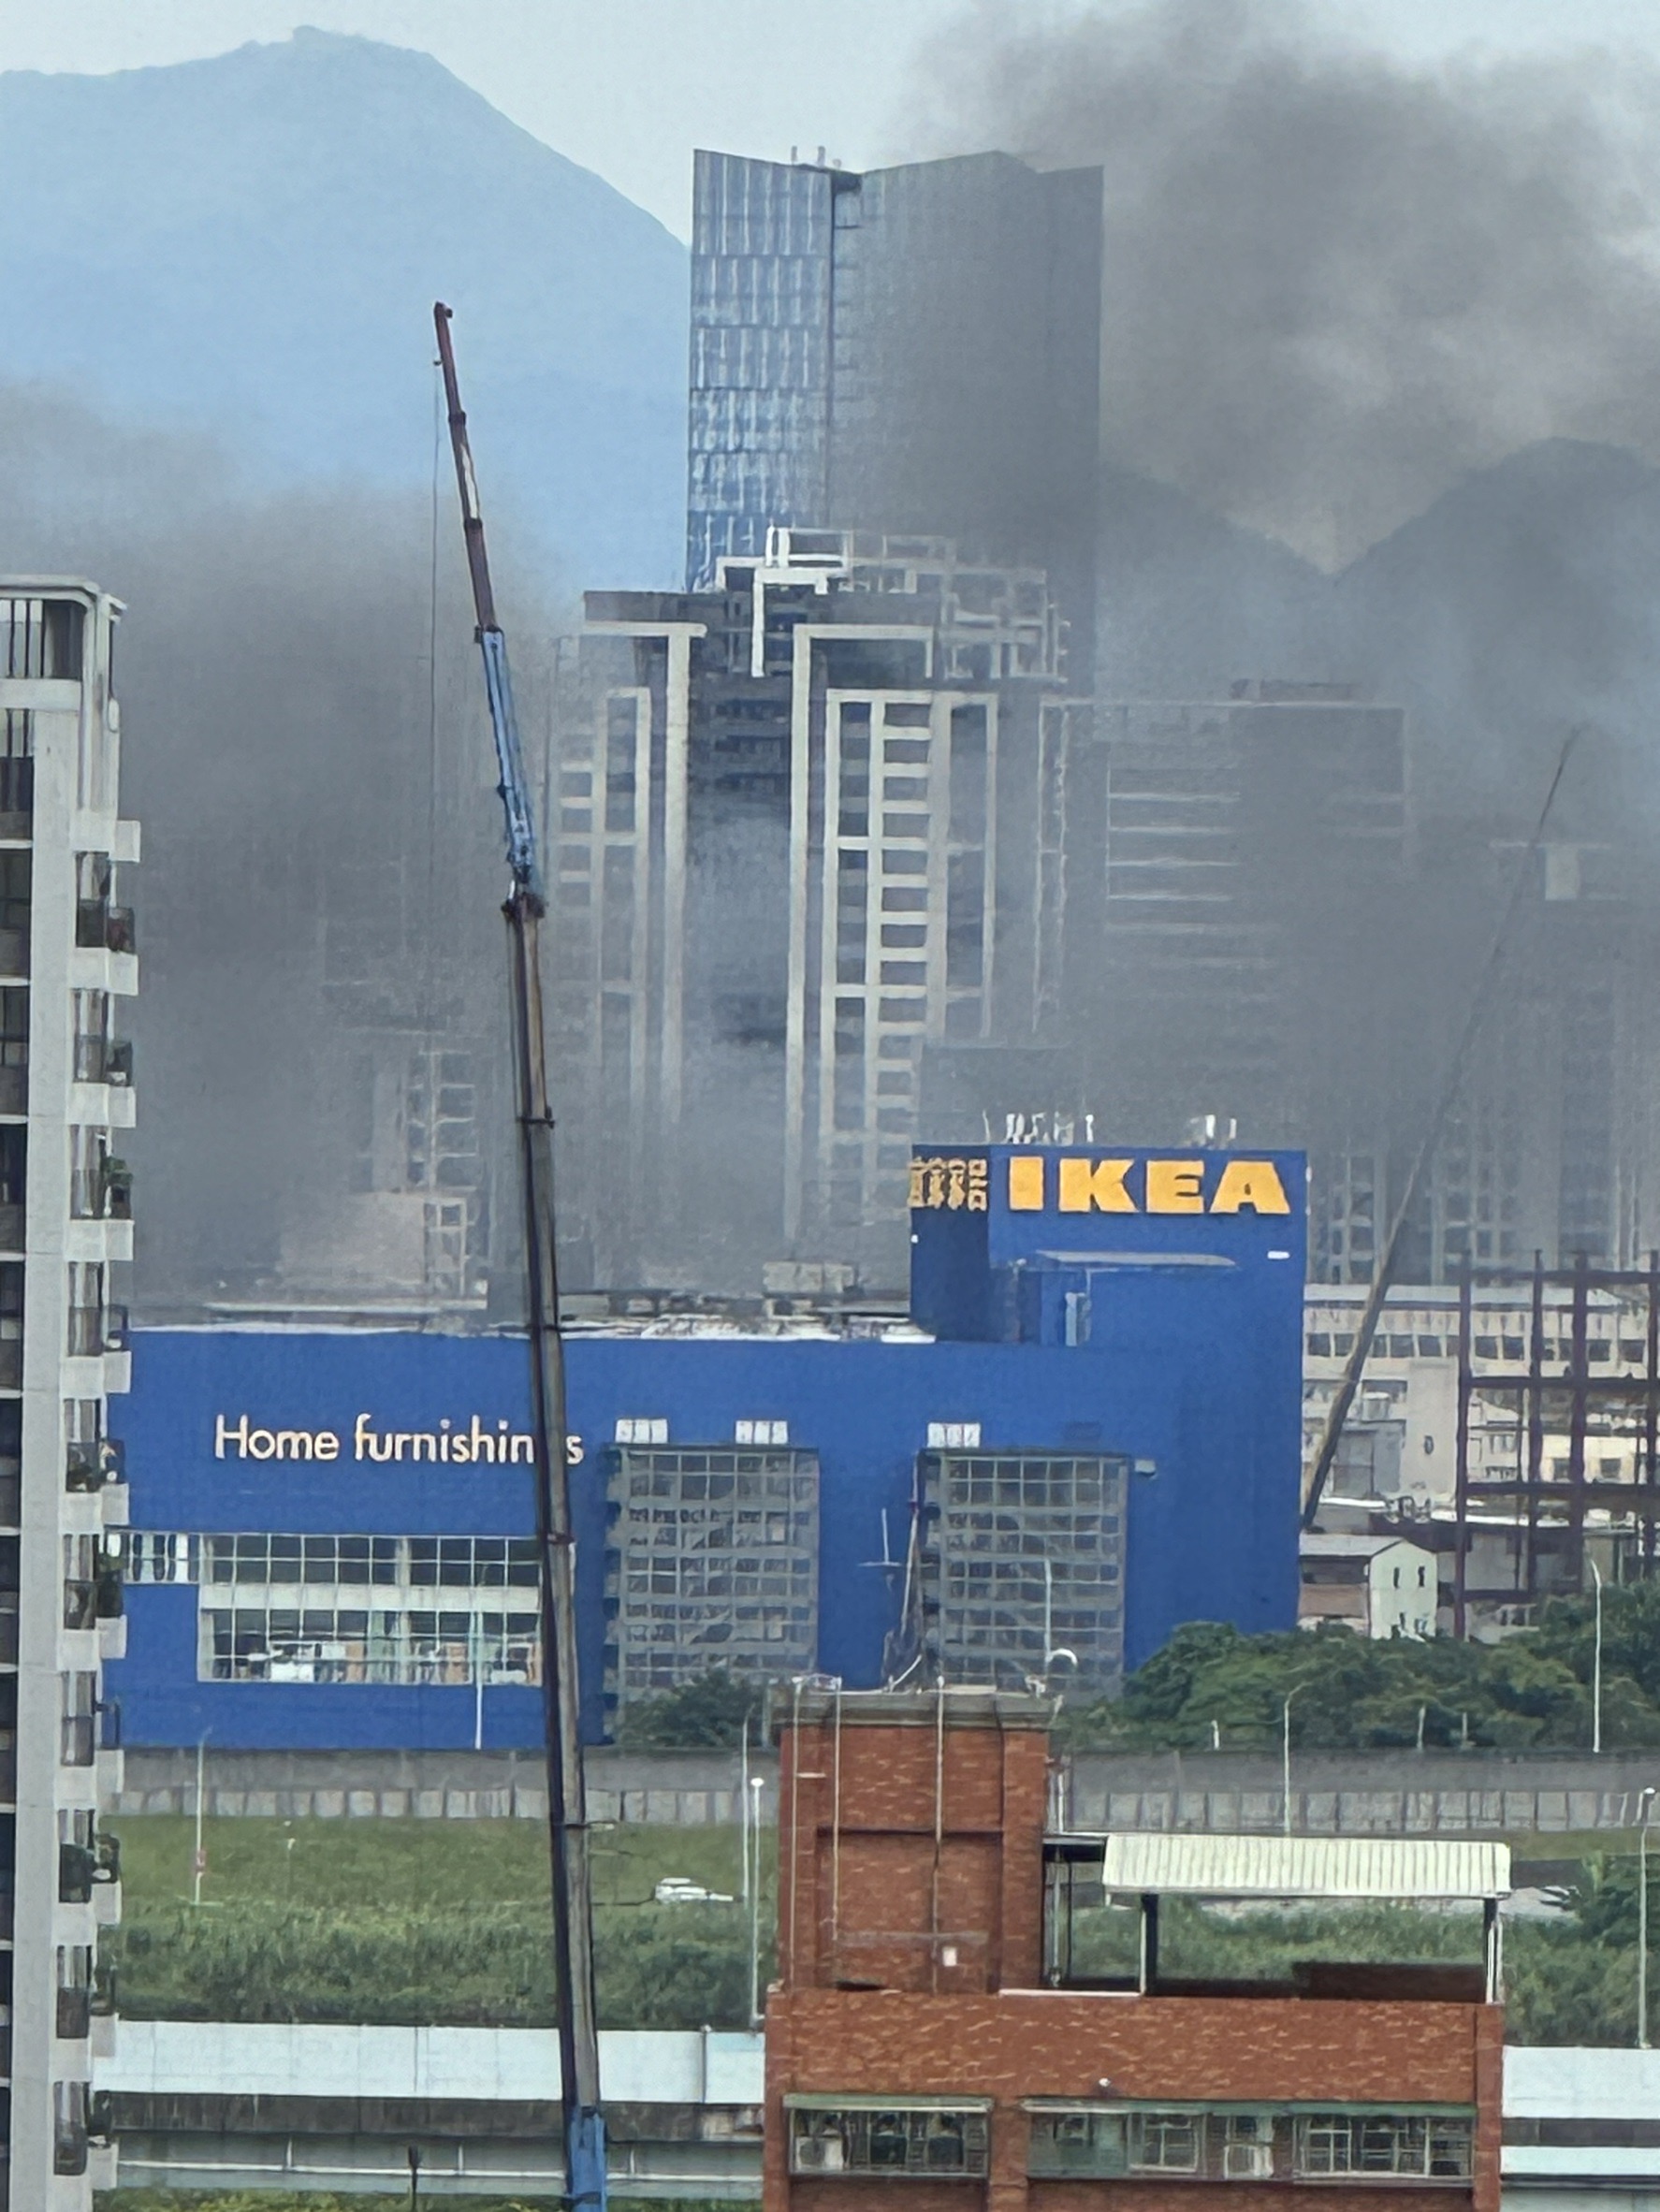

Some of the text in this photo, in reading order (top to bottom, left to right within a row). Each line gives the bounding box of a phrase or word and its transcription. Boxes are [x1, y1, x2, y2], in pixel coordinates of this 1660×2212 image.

[1010, 1157, 1290, 1215] IKEA
[215, 1413, 585, 1464] Home furnishins
